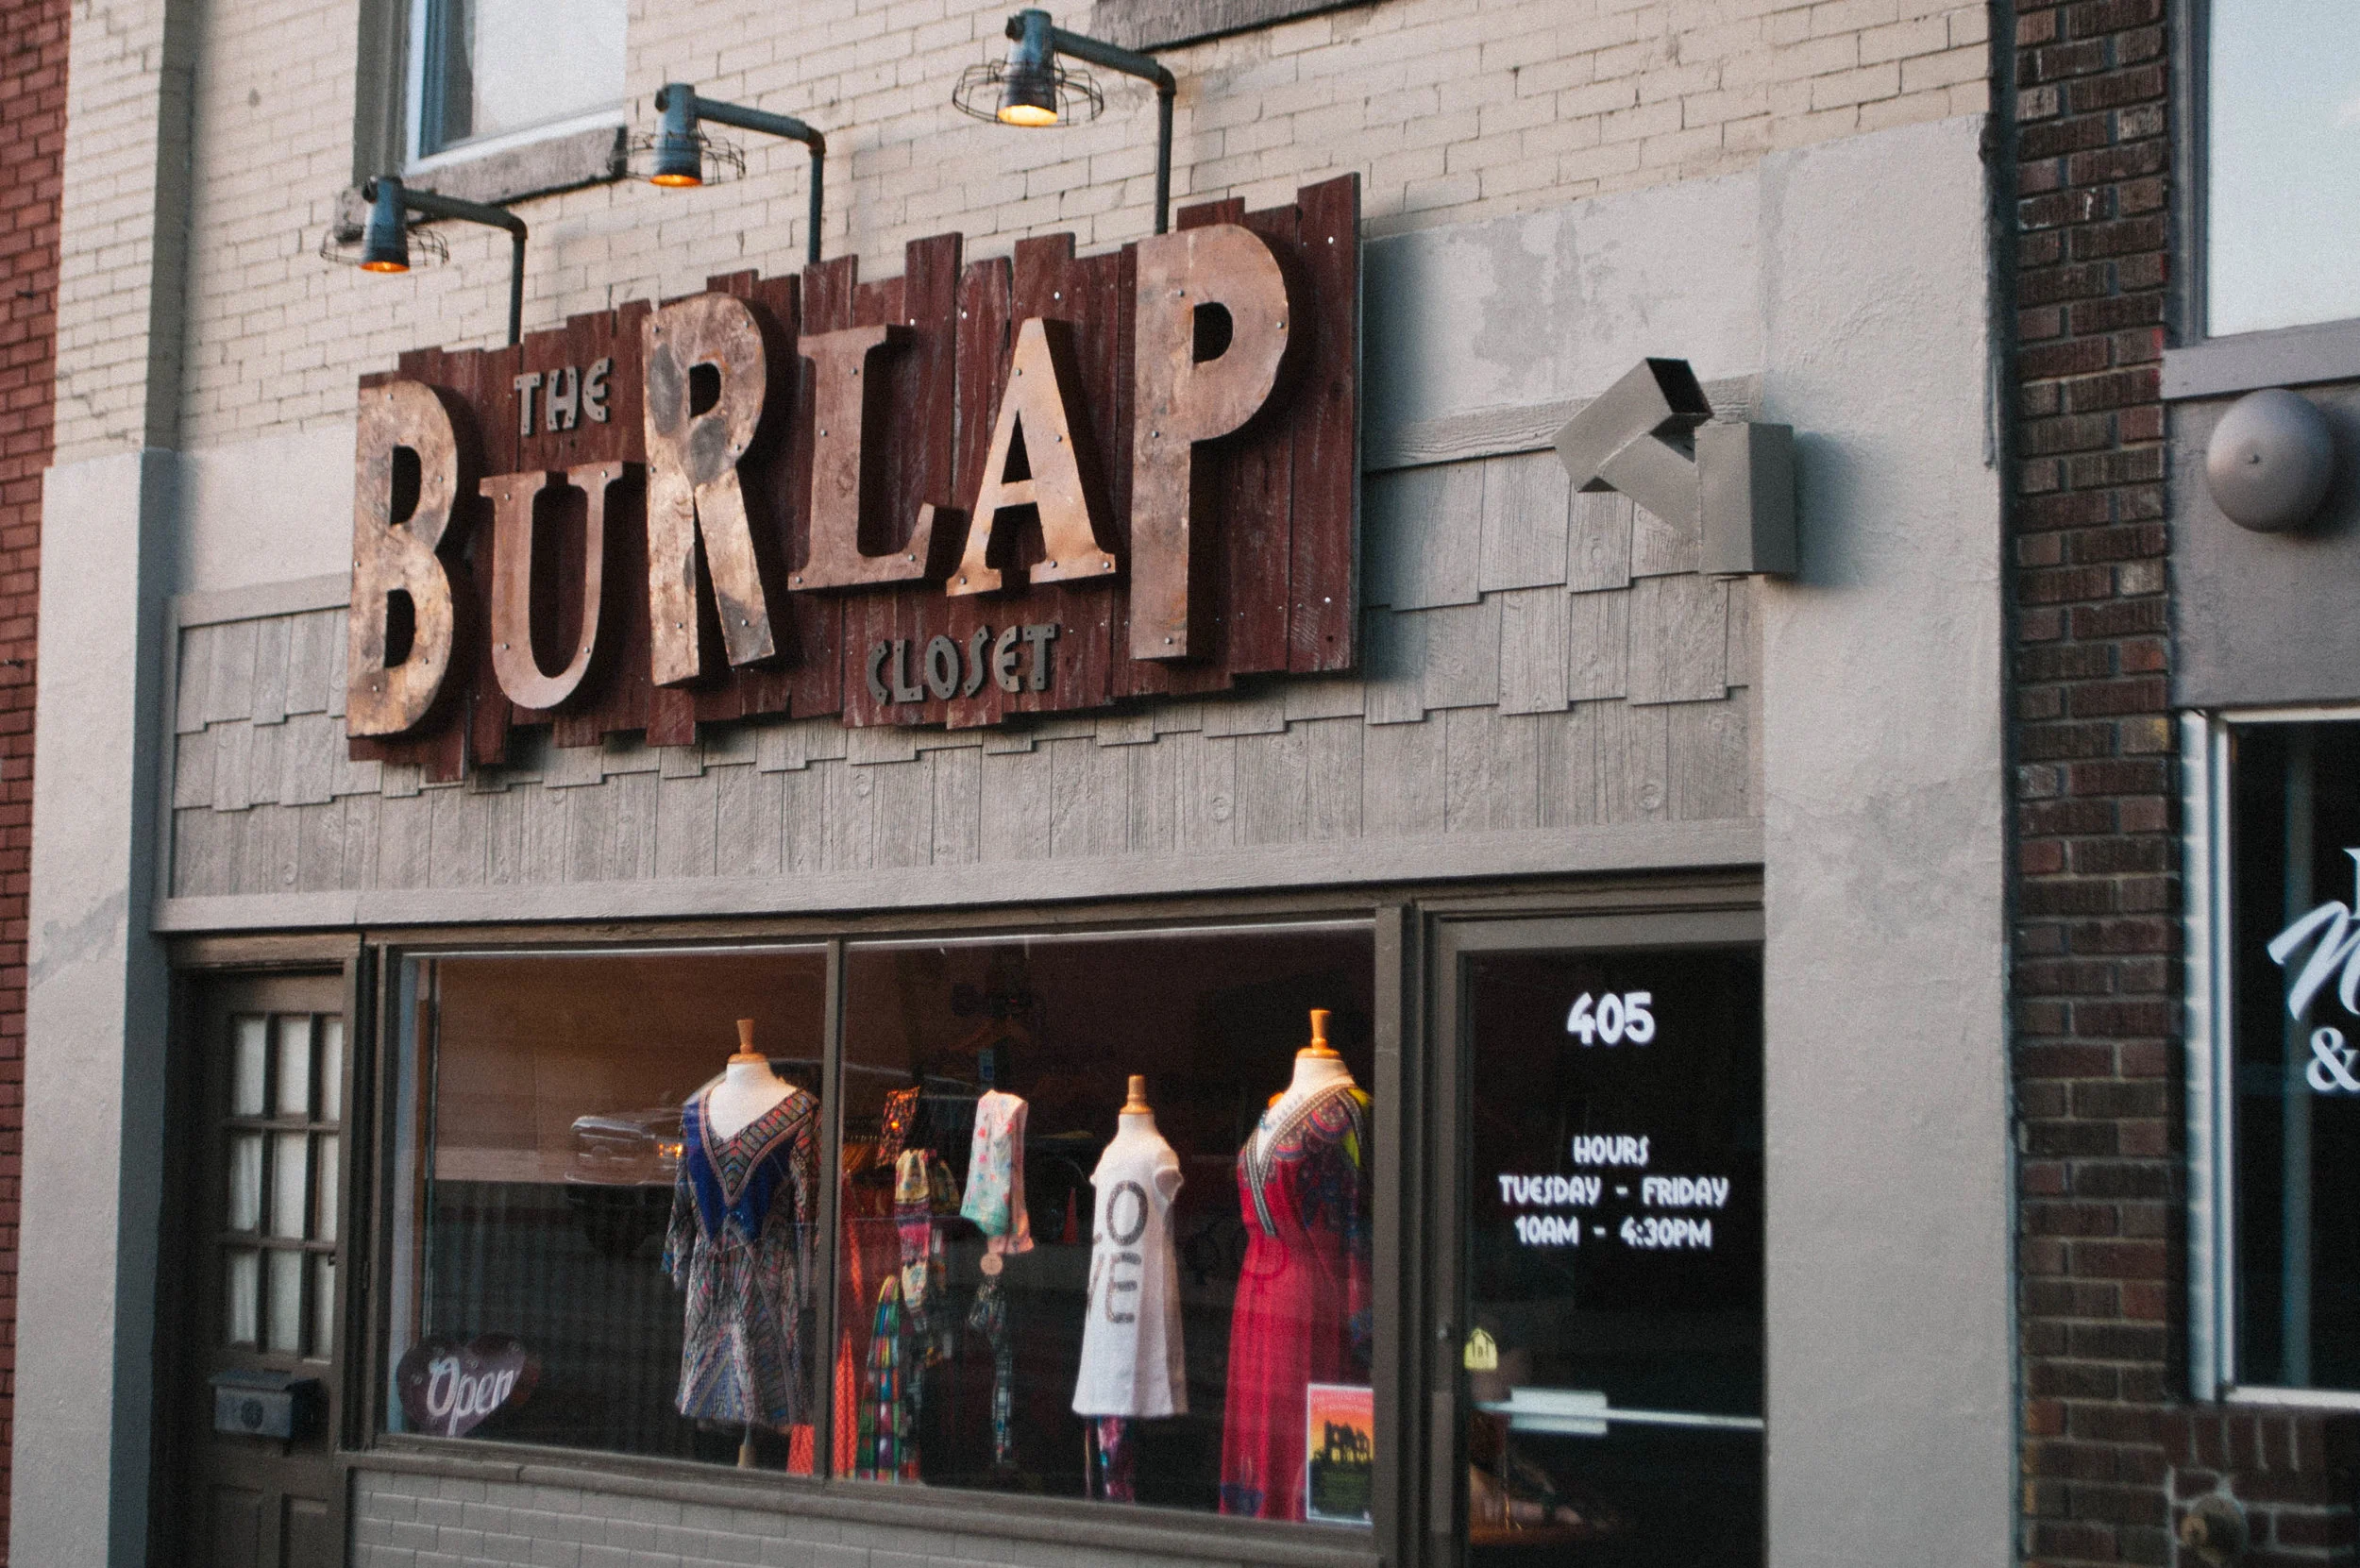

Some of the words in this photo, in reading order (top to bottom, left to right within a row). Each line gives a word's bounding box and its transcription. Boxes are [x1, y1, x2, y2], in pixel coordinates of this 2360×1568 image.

[514, 357, 613, 438] THE
[346, 223, 1290, 737] BURLAP
[867, 623, 1060, 705] CLOSET
[1566, 991, 1656, 1046] 405
[1572, 1135, 1650, 1167] HOURS
[1498, 1174, 1602, 1206] TUESDAY
[1615, 1187, 1628, 1196] -
[1642, 1176, 1729, 1208] FRIDAY
[1514, 1215, 1580, 1246] 10AM
[1593, 1227, 1607, 1236] -
[1620, 1216, 1711, 1248] 4:30PM
[427, 1356, 515, 1438] Open
